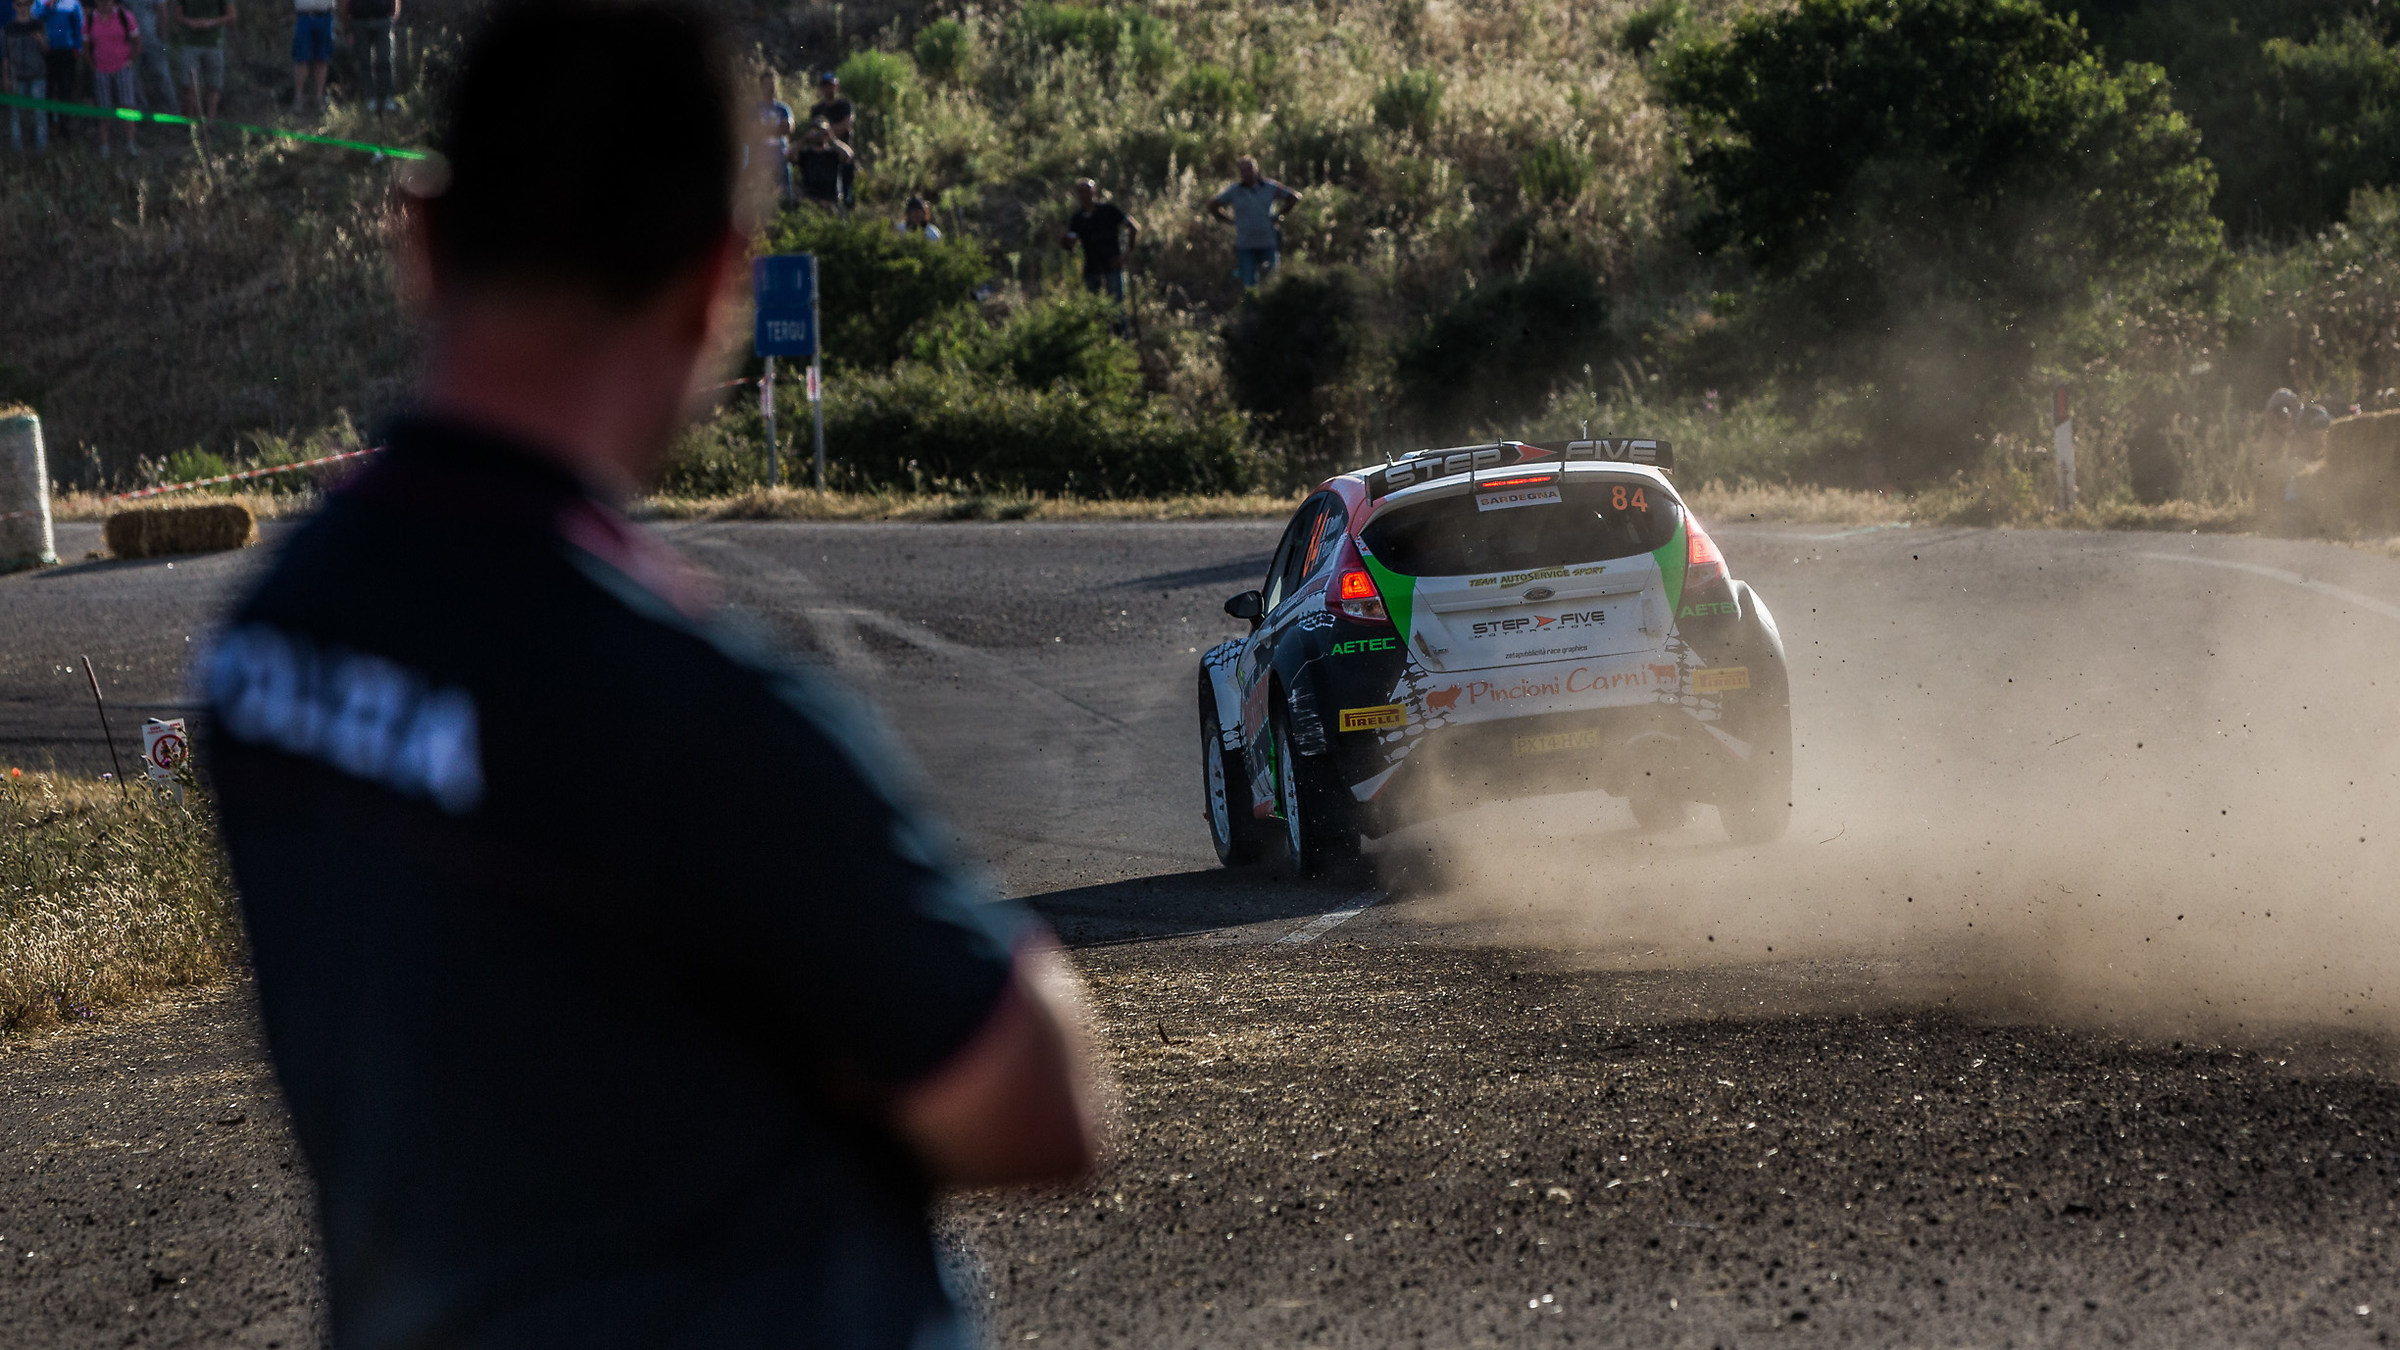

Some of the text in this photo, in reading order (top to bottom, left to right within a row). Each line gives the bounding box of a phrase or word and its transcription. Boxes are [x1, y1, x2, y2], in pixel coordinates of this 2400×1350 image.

[766, 320, 805, 341] TERGU
[1385, 440, 1657, 490] STEP FIVE
[1480, 489, 1559, 506] SARDEGNA
[1611, 486, 1648, 513] 84
[1469, 577, 1498, 588] TEAM
[1572, 566, 1607, 577] SPORT
[1472, 611, 1605, 635] STEP FIVE
[1474, 622, 1606, 639] MOTORSPORT
[1331, 637, 1396, 656] AETEC
[1562, 644, 1588, 655] graphics
[1466, 663, 1650, 705] Pincioni Carni
[1344, 708, 1400, 728] PIRELLI
